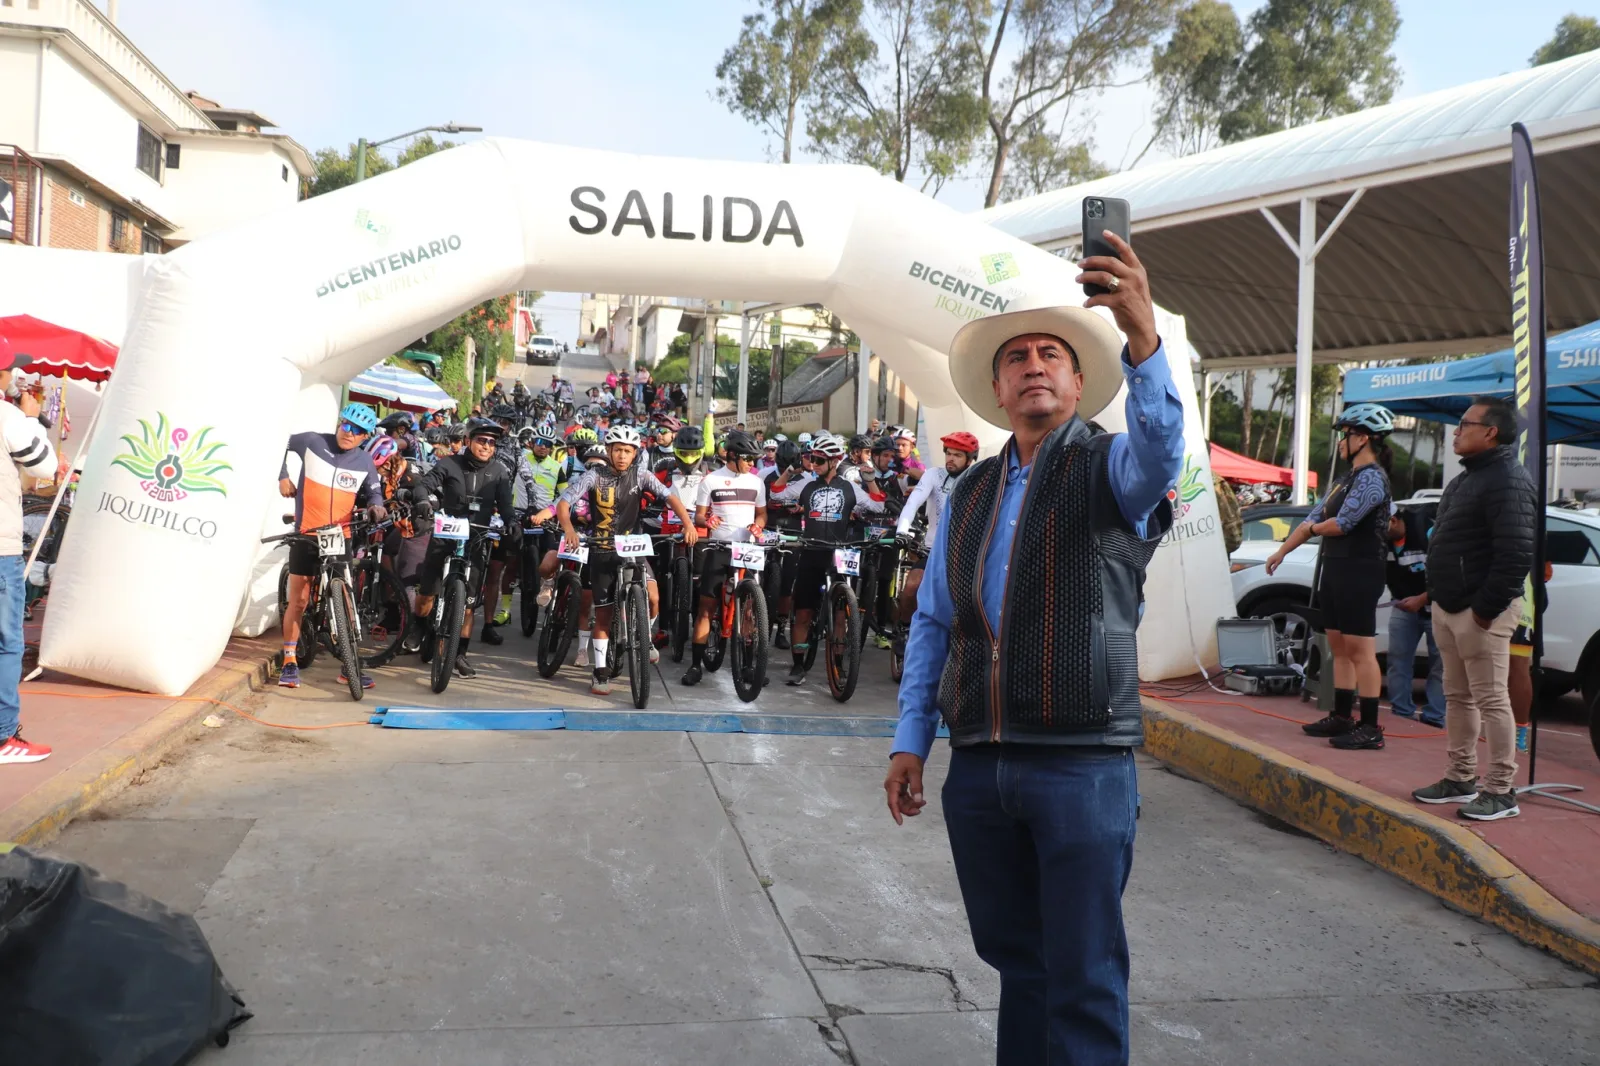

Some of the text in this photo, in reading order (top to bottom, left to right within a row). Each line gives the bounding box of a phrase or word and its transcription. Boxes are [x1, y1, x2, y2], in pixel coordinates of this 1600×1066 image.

[568, 185, 805, 248] SALIDA
[315, 234, 462, 298] BICENTENARIO
[746, 419, 769, 429] HIDALG
[781, 405, 816, 417] DENTAL
[97, 492, 217, 538] JIQUIPILCO
[442, 523, 461, 533] 211
